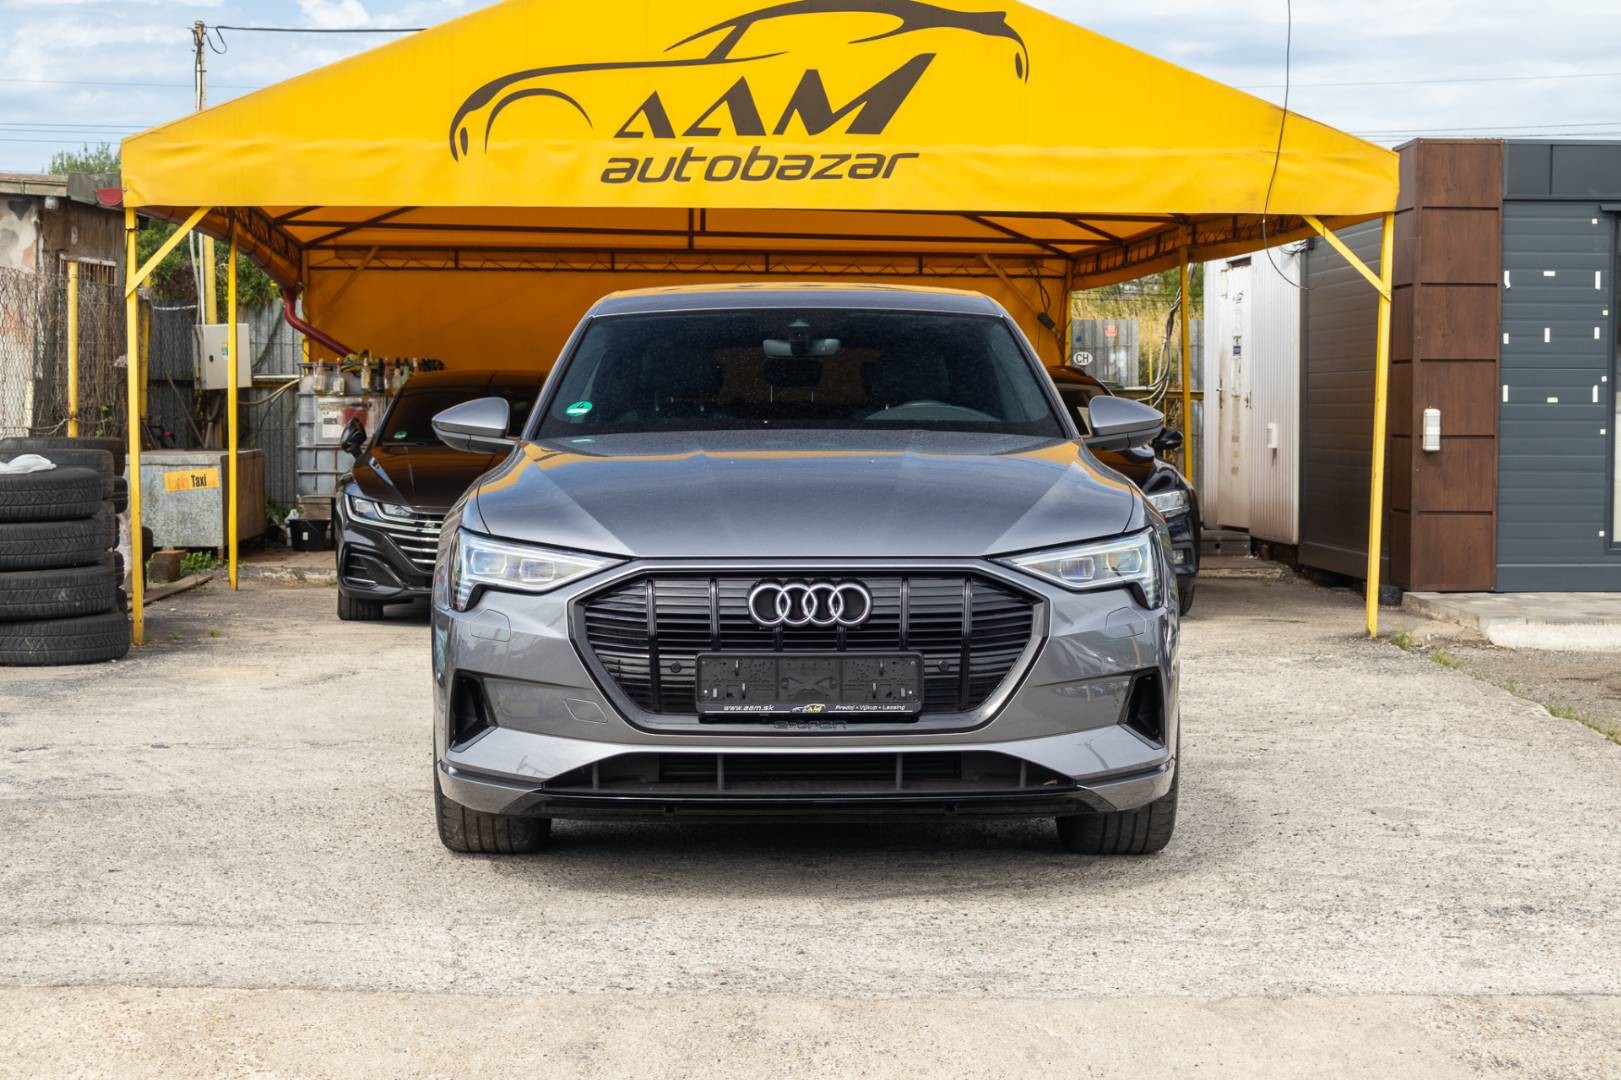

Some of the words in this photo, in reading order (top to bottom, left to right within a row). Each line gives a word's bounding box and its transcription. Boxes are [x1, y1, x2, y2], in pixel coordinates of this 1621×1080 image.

[613, 52, 938, 139] AAM
[600, 145, 920, 184] autobazar
[1075, 353, 1089, 364] CH
[191, 473, 207, 488] Taxi
[723, 704, 775, 712] www.aam.sk
